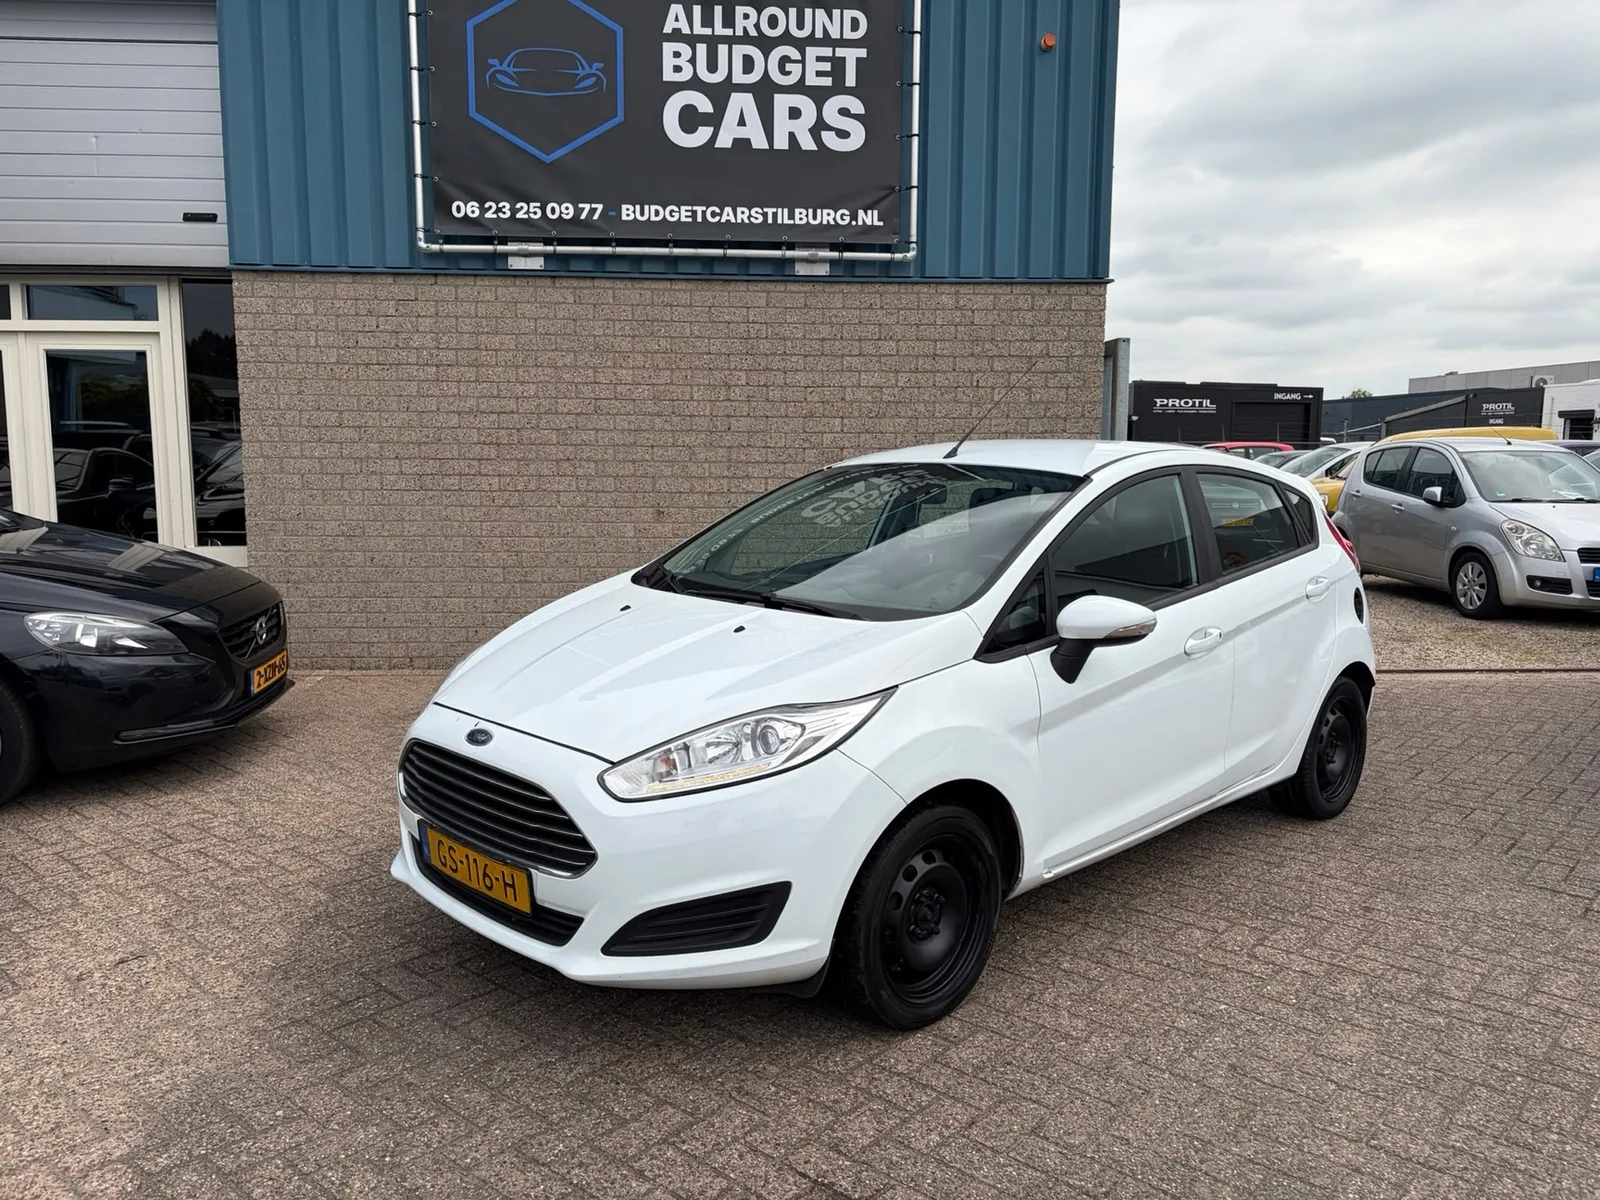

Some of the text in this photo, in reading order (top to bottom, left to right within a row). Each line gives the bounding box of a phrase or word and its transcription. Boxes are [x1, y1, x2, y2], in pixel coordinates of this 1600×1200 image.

[662, 3, 868, 40] ALLROUND
[662, 42, 868, 87] BUDGET
[662, 90, 866, 152] CARS
[451, 201, 480, 218] 06
[484, 202, 511, 219] 23
[515, 202, 542, 219] 25
[545, 203, 575, 220] 09
[578, 203, 604, 220] 77
[621, 204, 884, 226] BUDGETCARSTILBURG.NL
[1153, 398, 1217, 408] PROTIL
[1273, 392, 1302, 400] INGANG
[1481, 402, 1515, 411] PROTIL
[436, 839, 519, 902] GS-116-H
